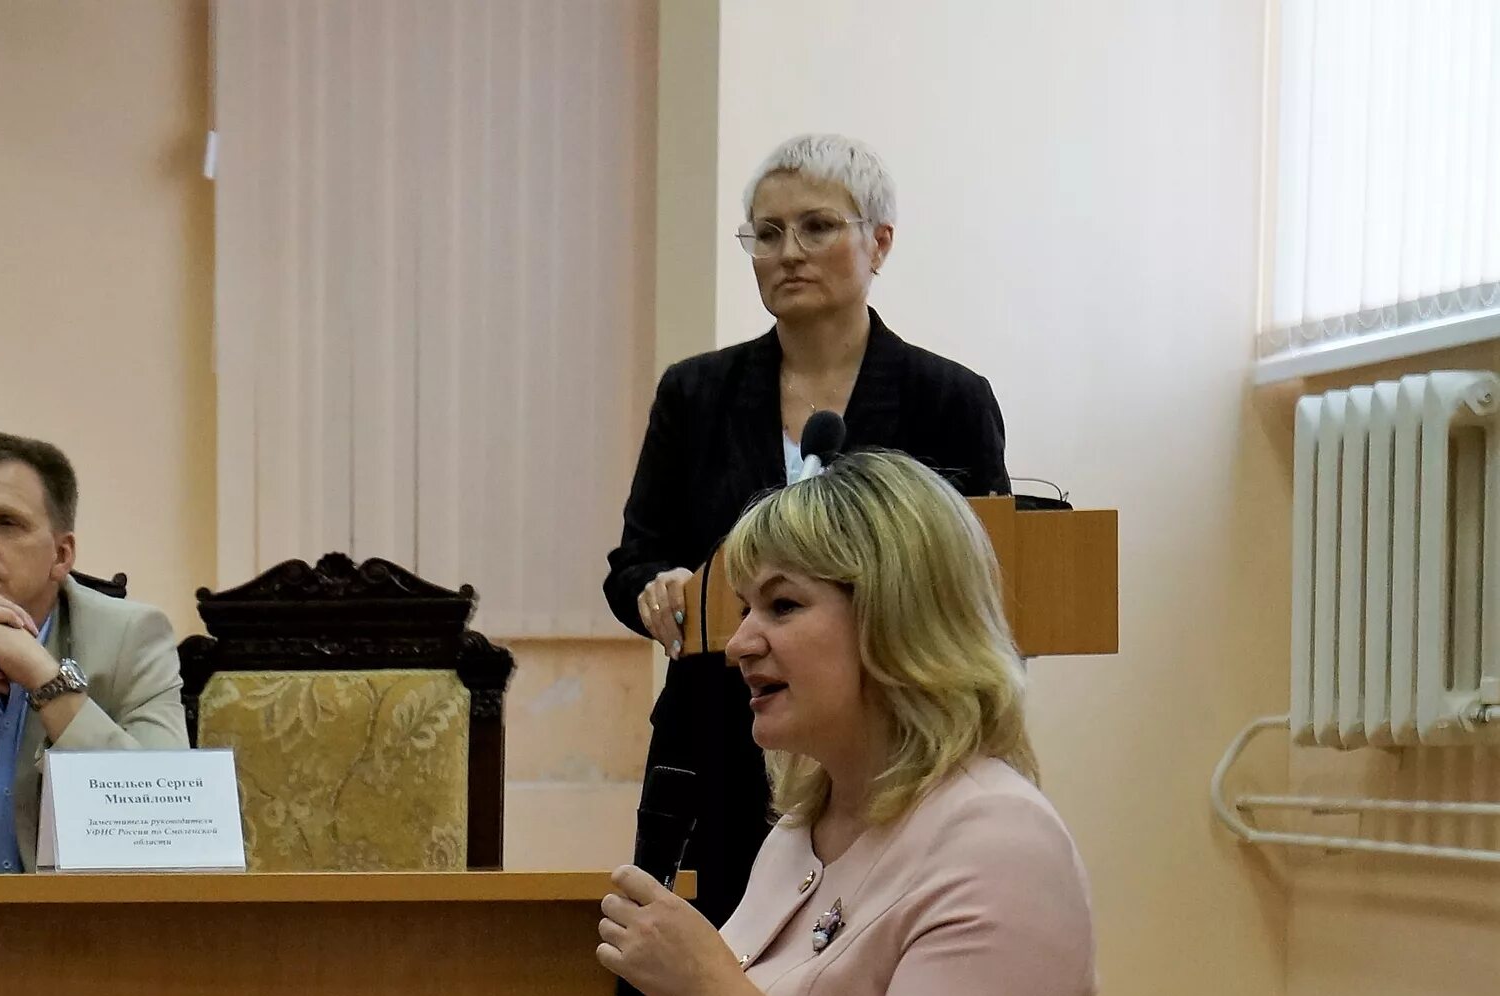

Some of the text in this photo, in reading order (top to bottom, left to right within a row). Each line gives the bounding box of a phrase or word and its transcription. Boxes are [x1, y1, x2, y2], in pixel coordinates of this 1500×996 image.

[89, 777, 204, 791] Васильев Сергей
[105, 793, 192, 804] Михайлович
